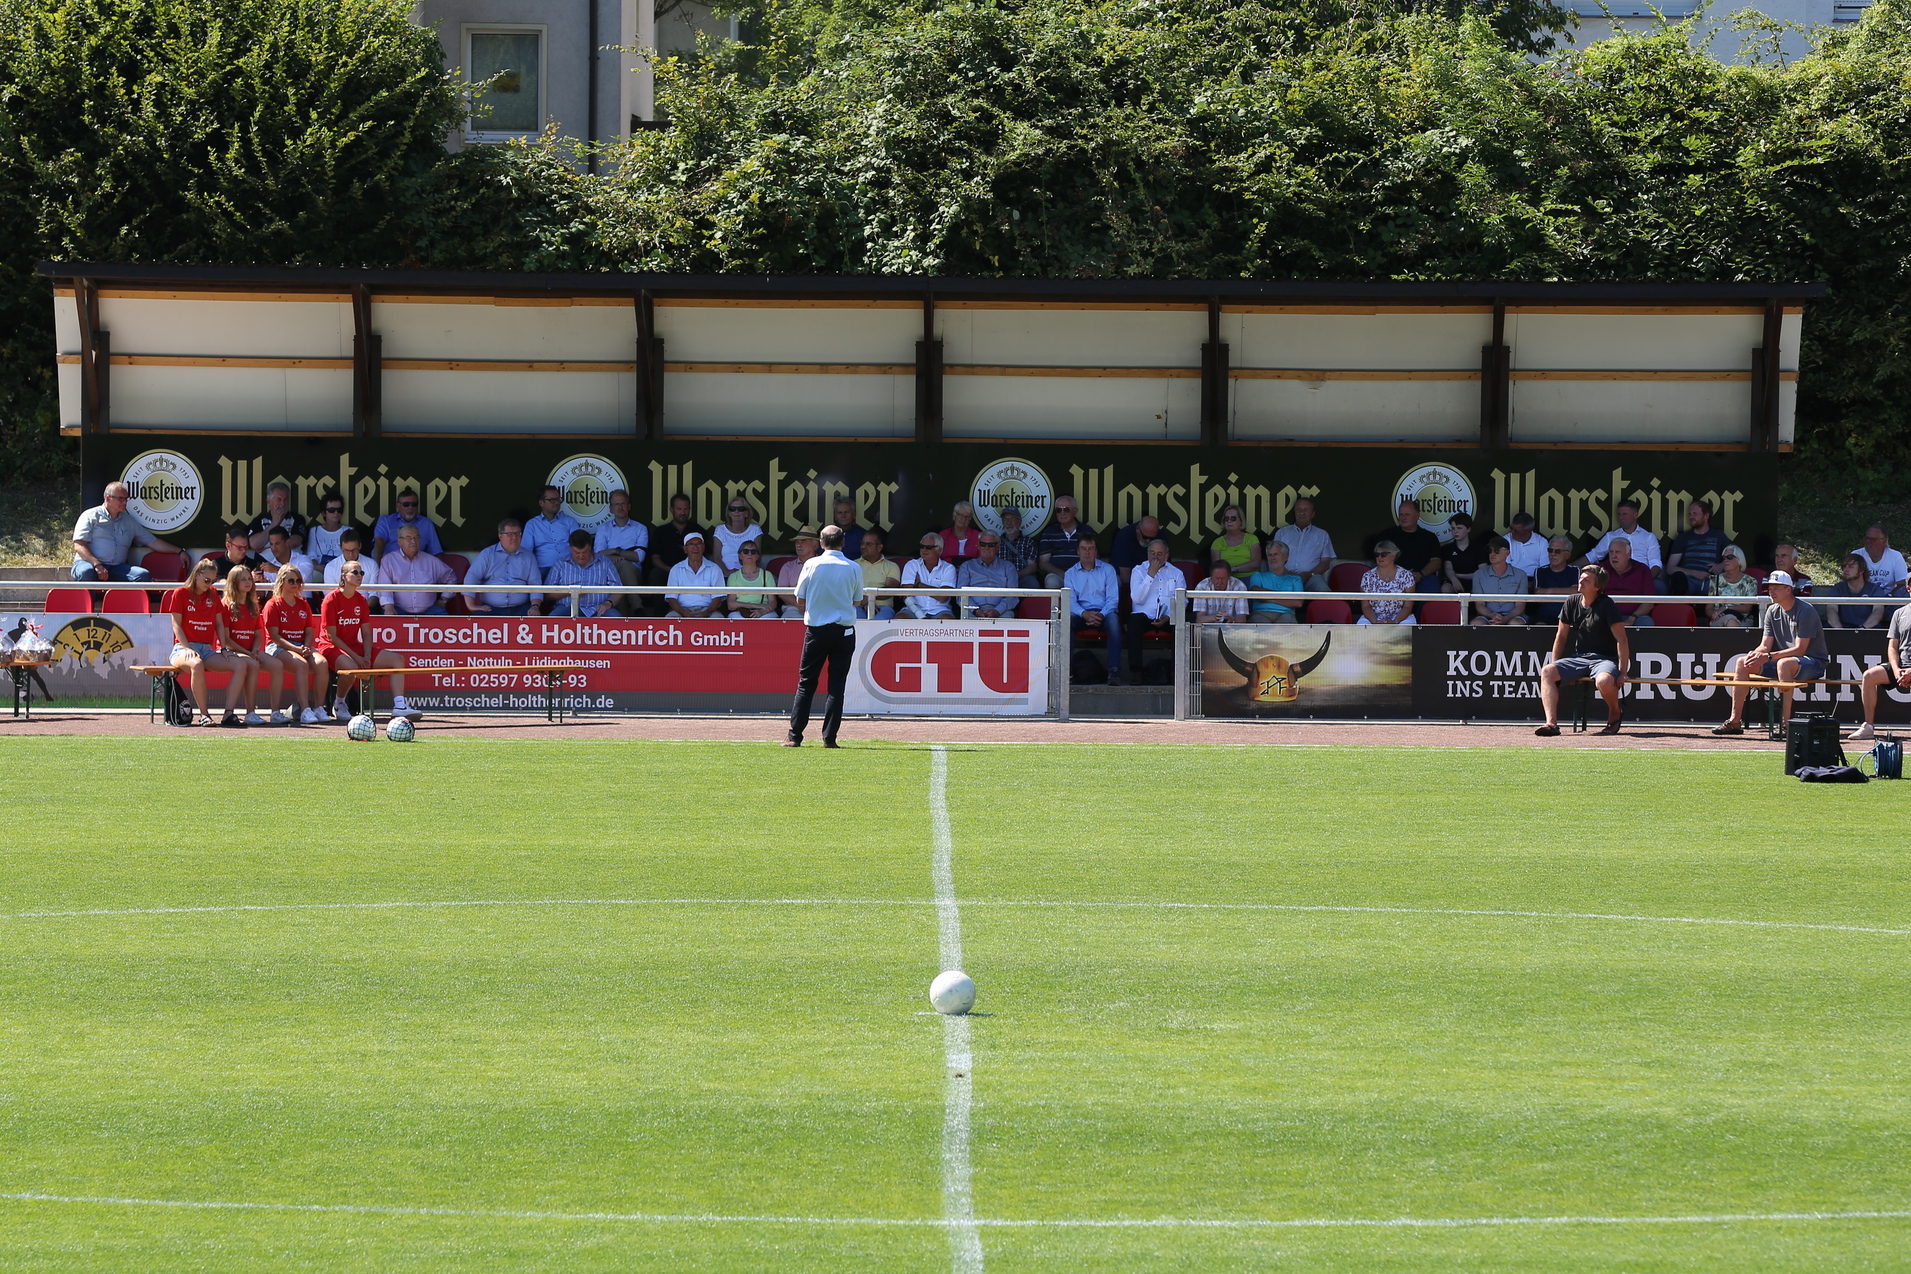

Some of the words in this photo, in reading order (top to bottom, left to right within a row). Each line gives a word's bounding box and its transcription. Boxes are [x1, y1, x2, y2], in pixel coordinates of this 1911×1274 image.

[126, 479, 196, 503] Warsteiner
[978, 487, 1047, 509] Warsteiner
[86, 628, 98, 639] 12
[101, 631, 112, 644] 11
[109, 640, 123, 654] 10
[402, 622, 509, 645] Troschel
[516, 624, 534, 645] &
[541, 623, 683, 646] Holthenrich
[690, 630, 744, 647] GmbH
[899, 628, 975, 638] VERTRAGSPARTNER
[408, 655, 455, 667] Senden
[466, 656, 512, 668] Nottuln
[525, 656, 611, 669] Lüdinghausen
[870, 629, 1030, 693] GTÜ
[431, 673, 465, 687] Tel.:
[470, 673, 518, 688] 02597
[1446, 680, 1483, 698] INS
